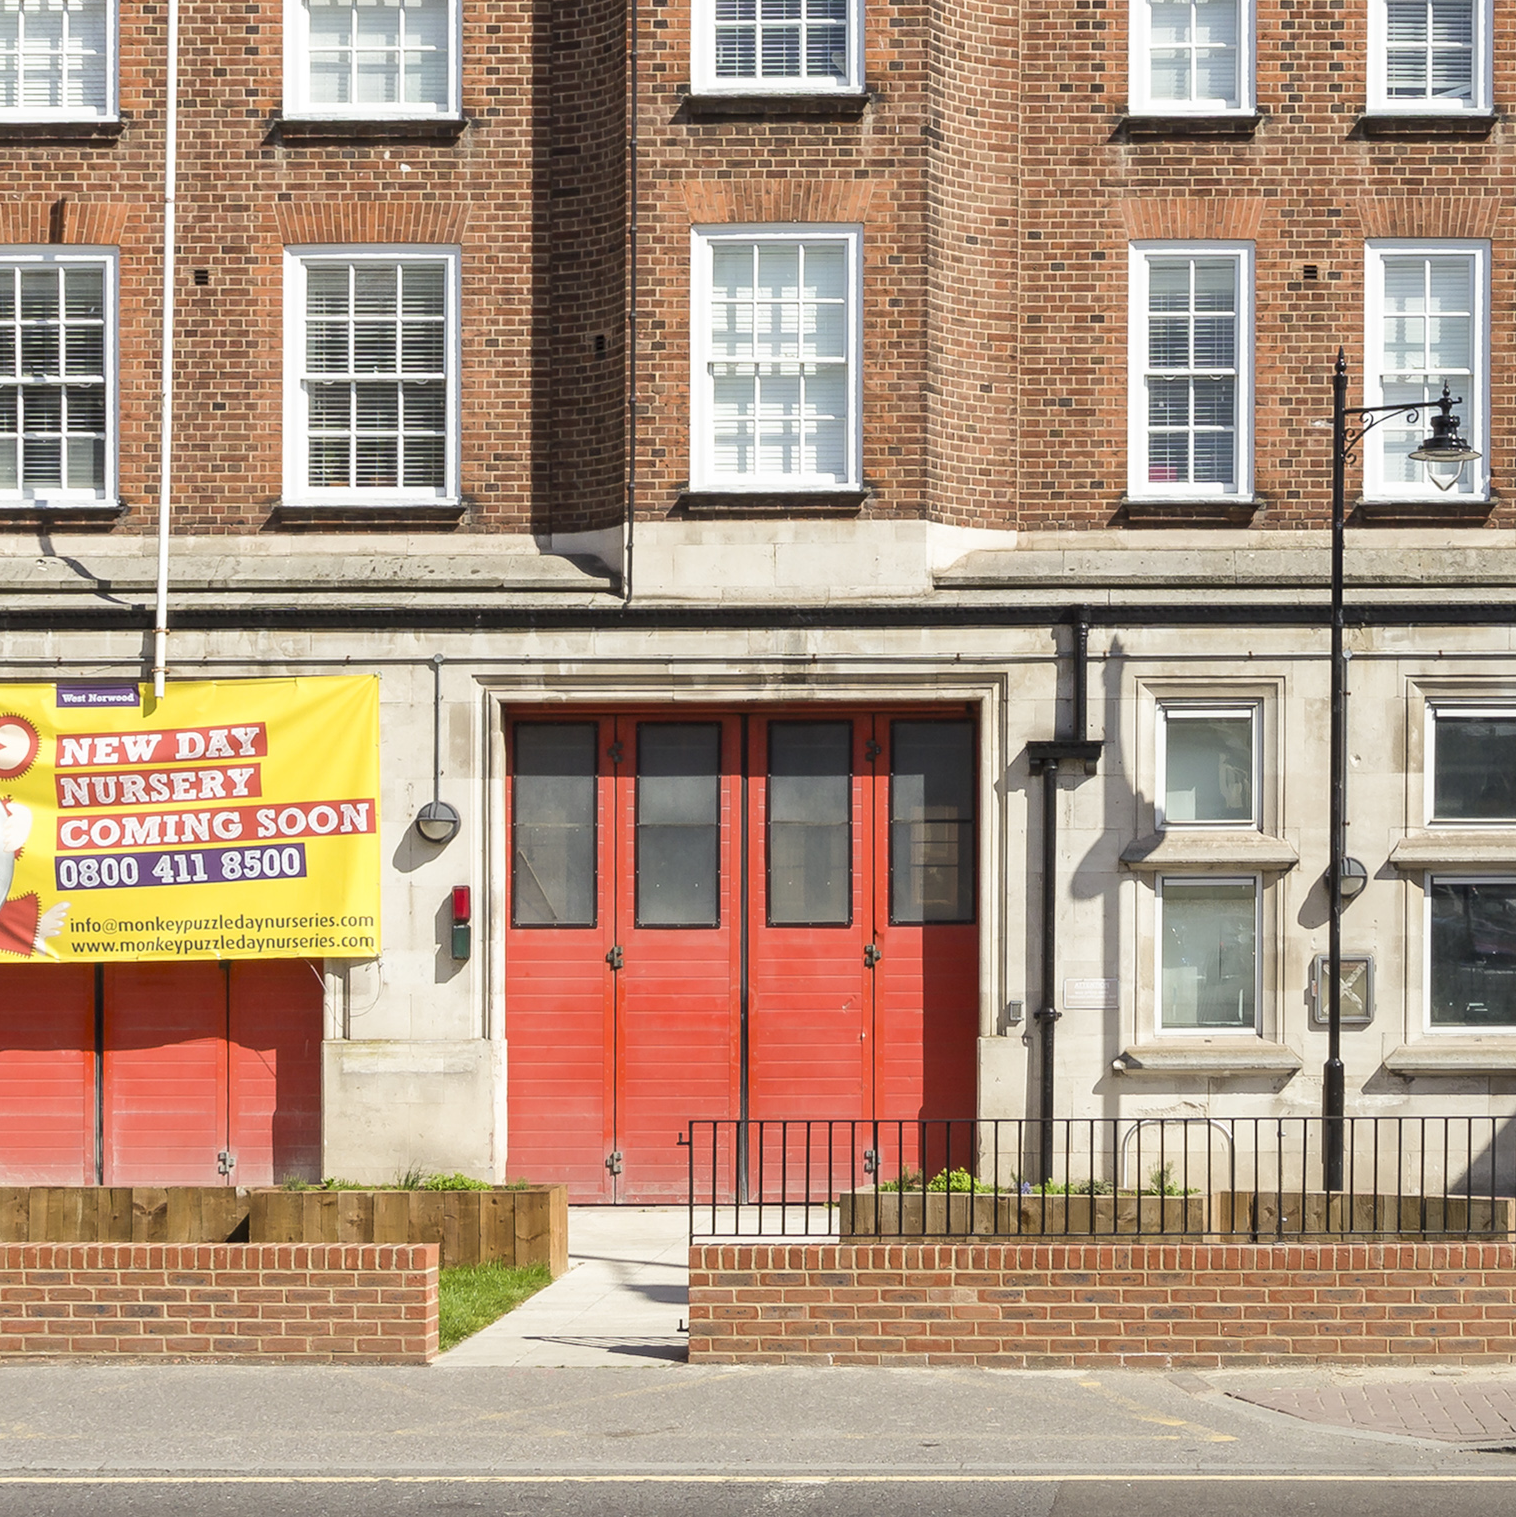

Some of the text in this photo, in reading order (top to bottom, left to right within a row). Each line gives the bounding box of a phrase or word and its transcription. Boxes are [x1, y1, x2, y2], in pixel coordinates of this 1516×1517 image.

[62, 693, 134, 703] West Norwood
[60, 727, 260, 766] NEW DAY
[60, 768, 254, 806] NURSERY
[60, 803, 369, 848] COMING SOON
[60, 847, 300, 889] 0800 411 8500
[70, 913, 374, 935] info@monkeypuzzledaynurseries.com
[71, 933, 374, 954] www.monkeypuzzledaynurseries.com
